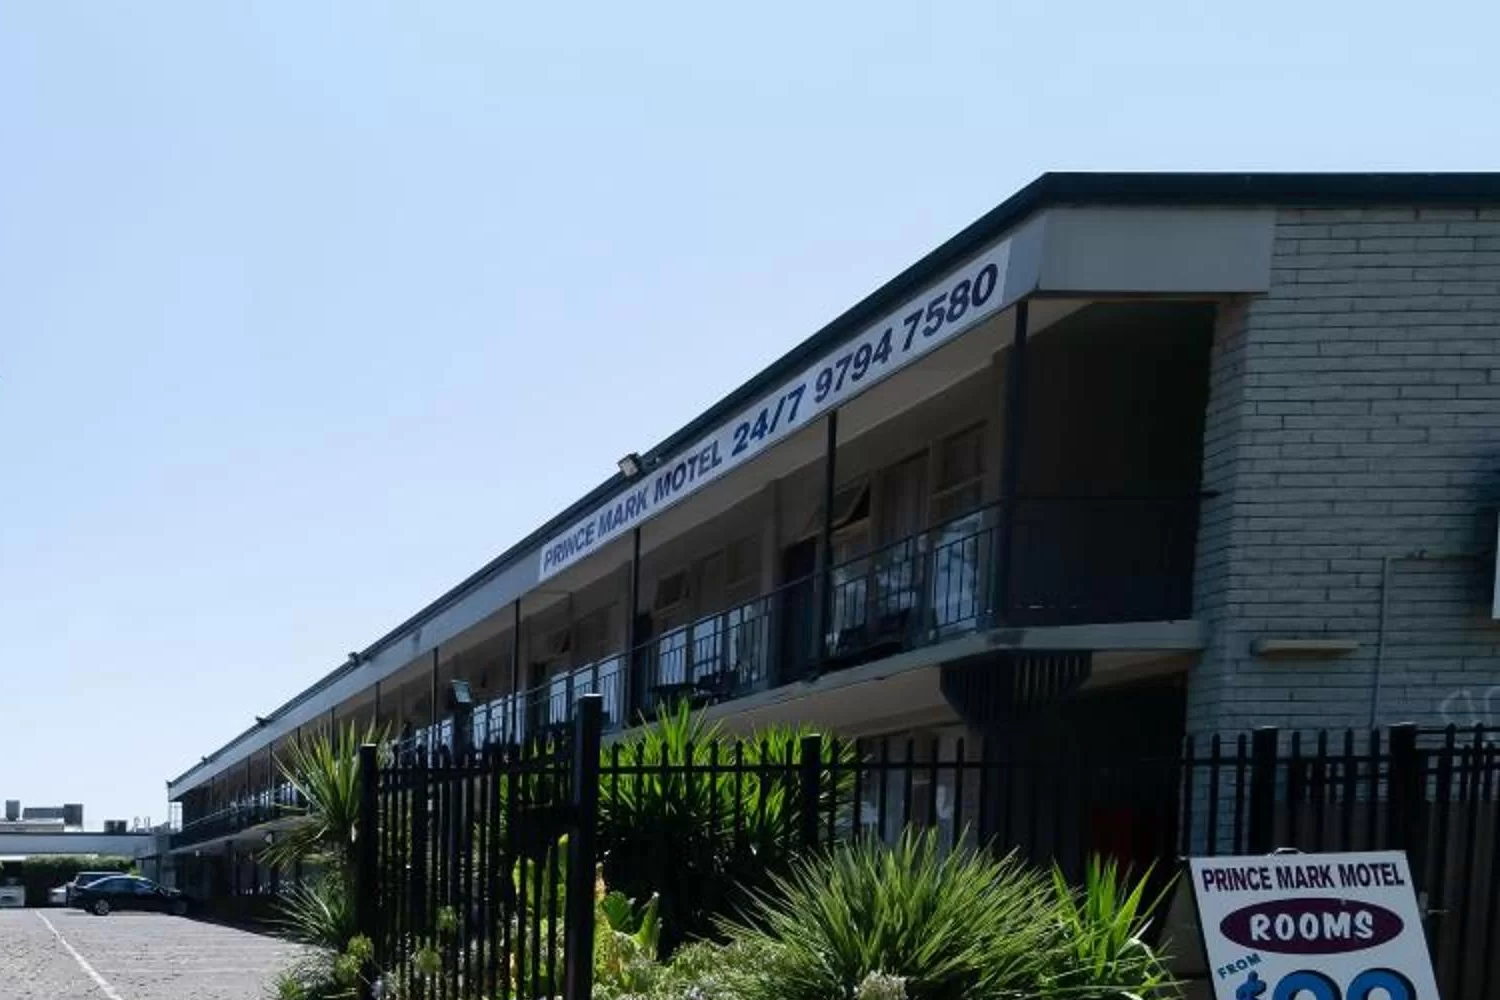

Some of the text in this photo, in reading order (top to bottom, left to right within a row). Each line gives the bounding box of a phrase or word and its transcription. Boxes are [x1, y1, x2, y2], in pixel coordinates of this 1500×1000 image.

[543, 263, 998, 573] PRINCE MARK MOTEL 24/7 9794 7580
[1202, 862, 1405, 892] PRINCE MARK MOTEL
[1250, 910, 1374, 942] ROOMS
[1217, 953, 1263, 980] FROM
